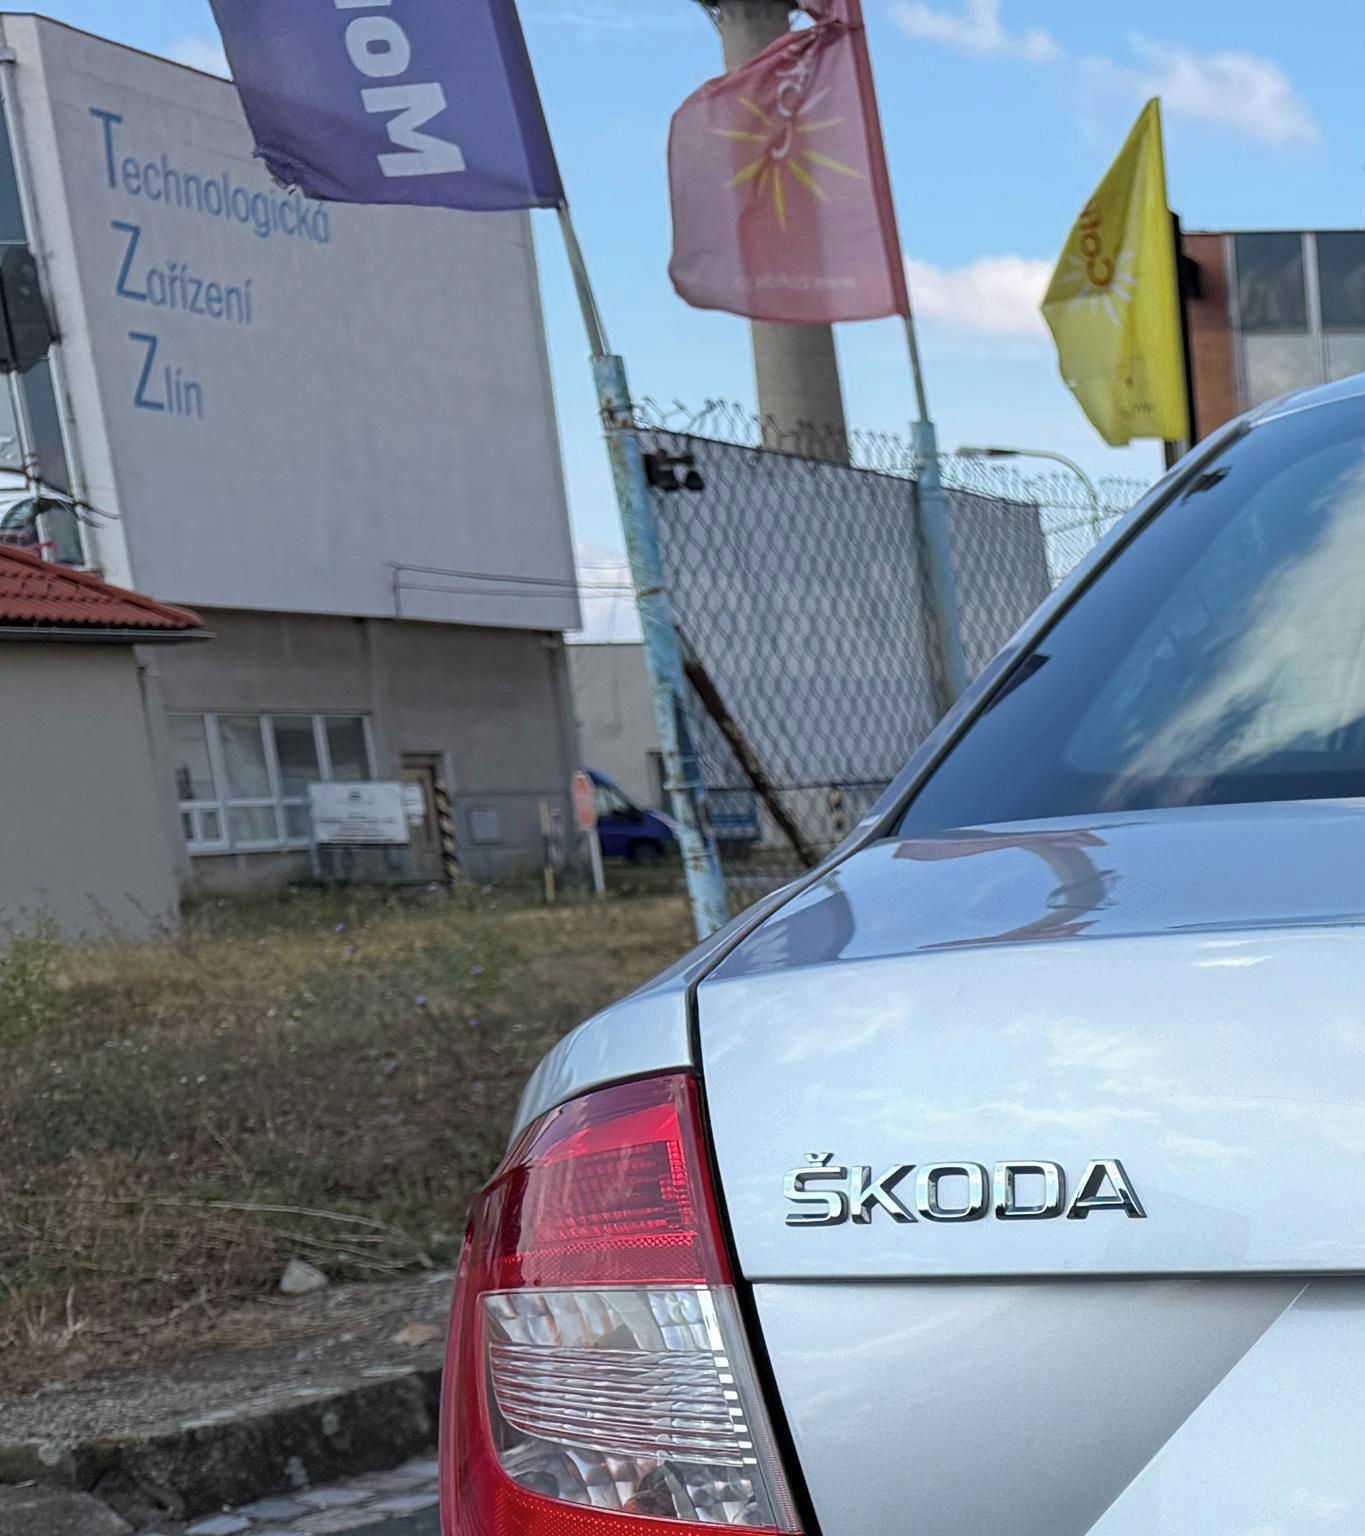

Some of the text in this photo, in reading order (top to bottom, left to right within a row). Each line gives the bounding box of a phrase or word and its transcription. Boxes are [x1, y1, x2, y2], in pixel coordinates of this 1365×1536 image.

[89, 106, 331, 244] Technologická
[110, 219, 254, 325] Zařízení
[128, 330, 205, 420] Zlín
[783, 1152, 1148, 1227] ŠKODA
